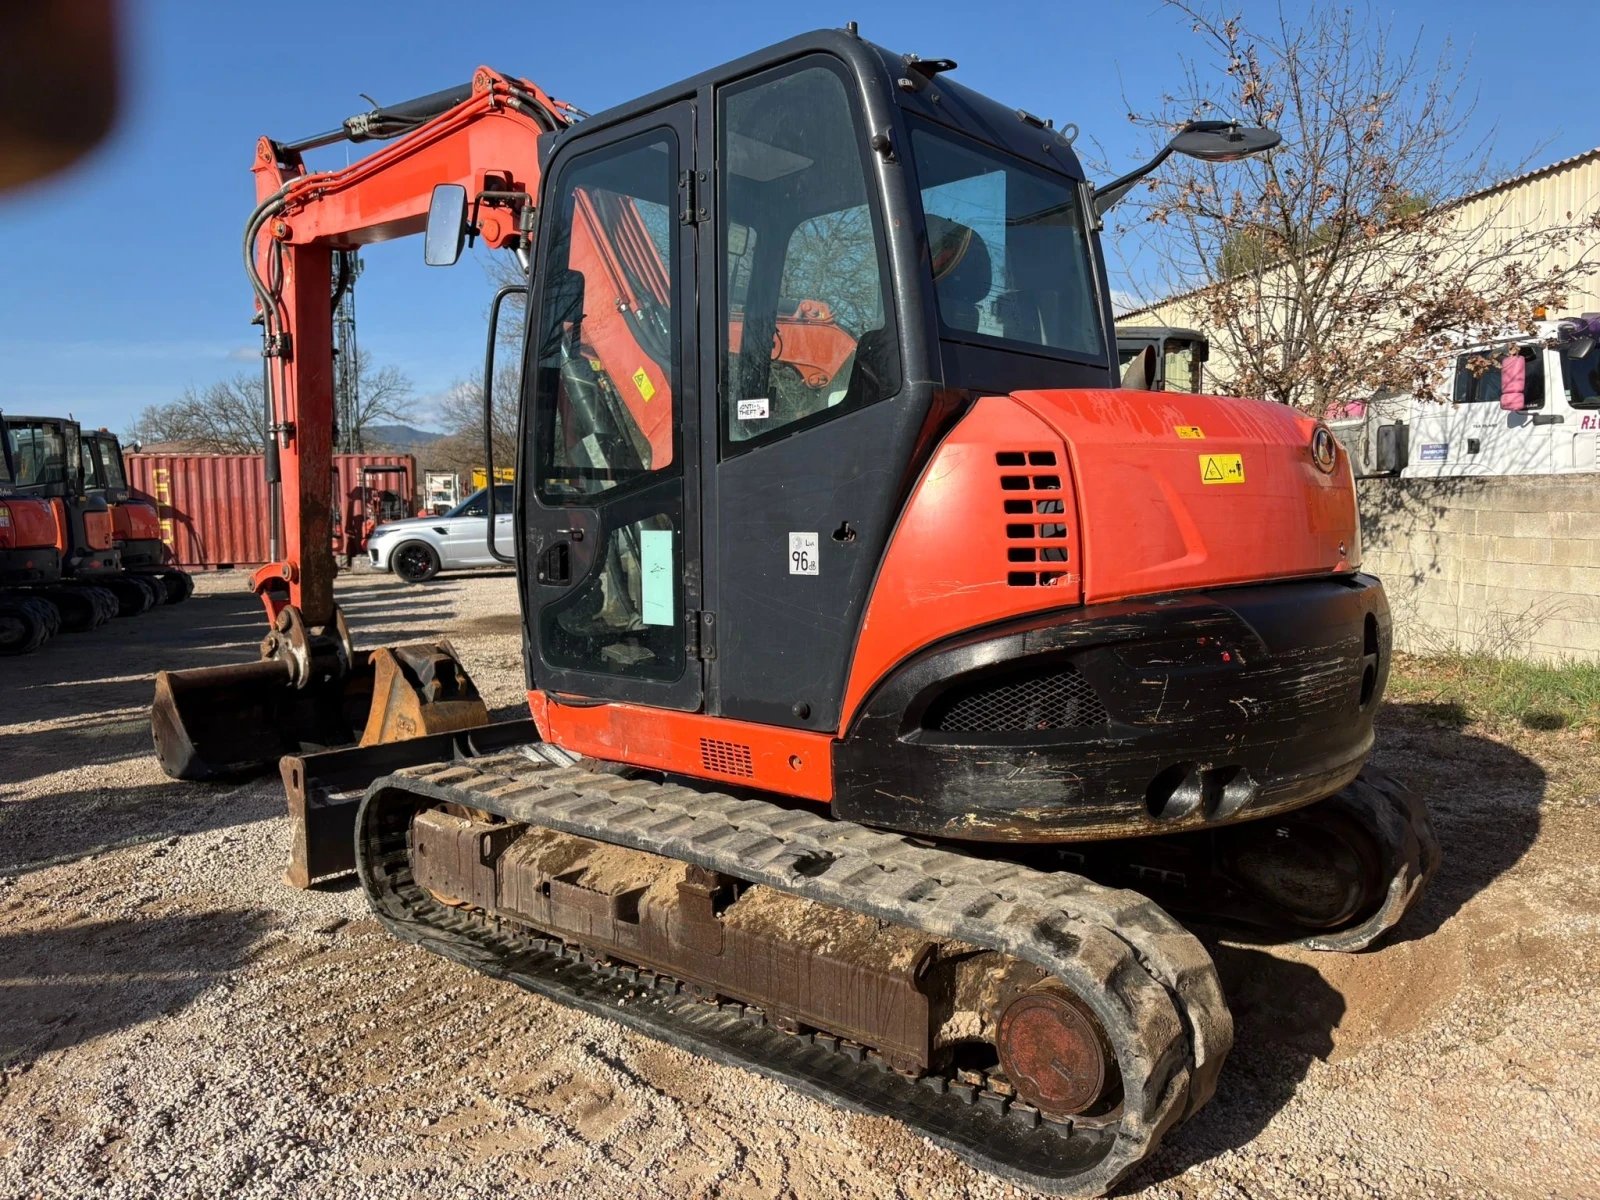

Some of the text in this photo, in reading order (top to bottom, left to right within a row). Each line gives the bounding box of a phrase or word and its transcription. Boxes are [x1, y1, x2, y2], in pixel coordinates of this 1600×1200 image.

[1581, 414, 1600, 430] Ri
[792, 550, 816, 571] 96 dB
